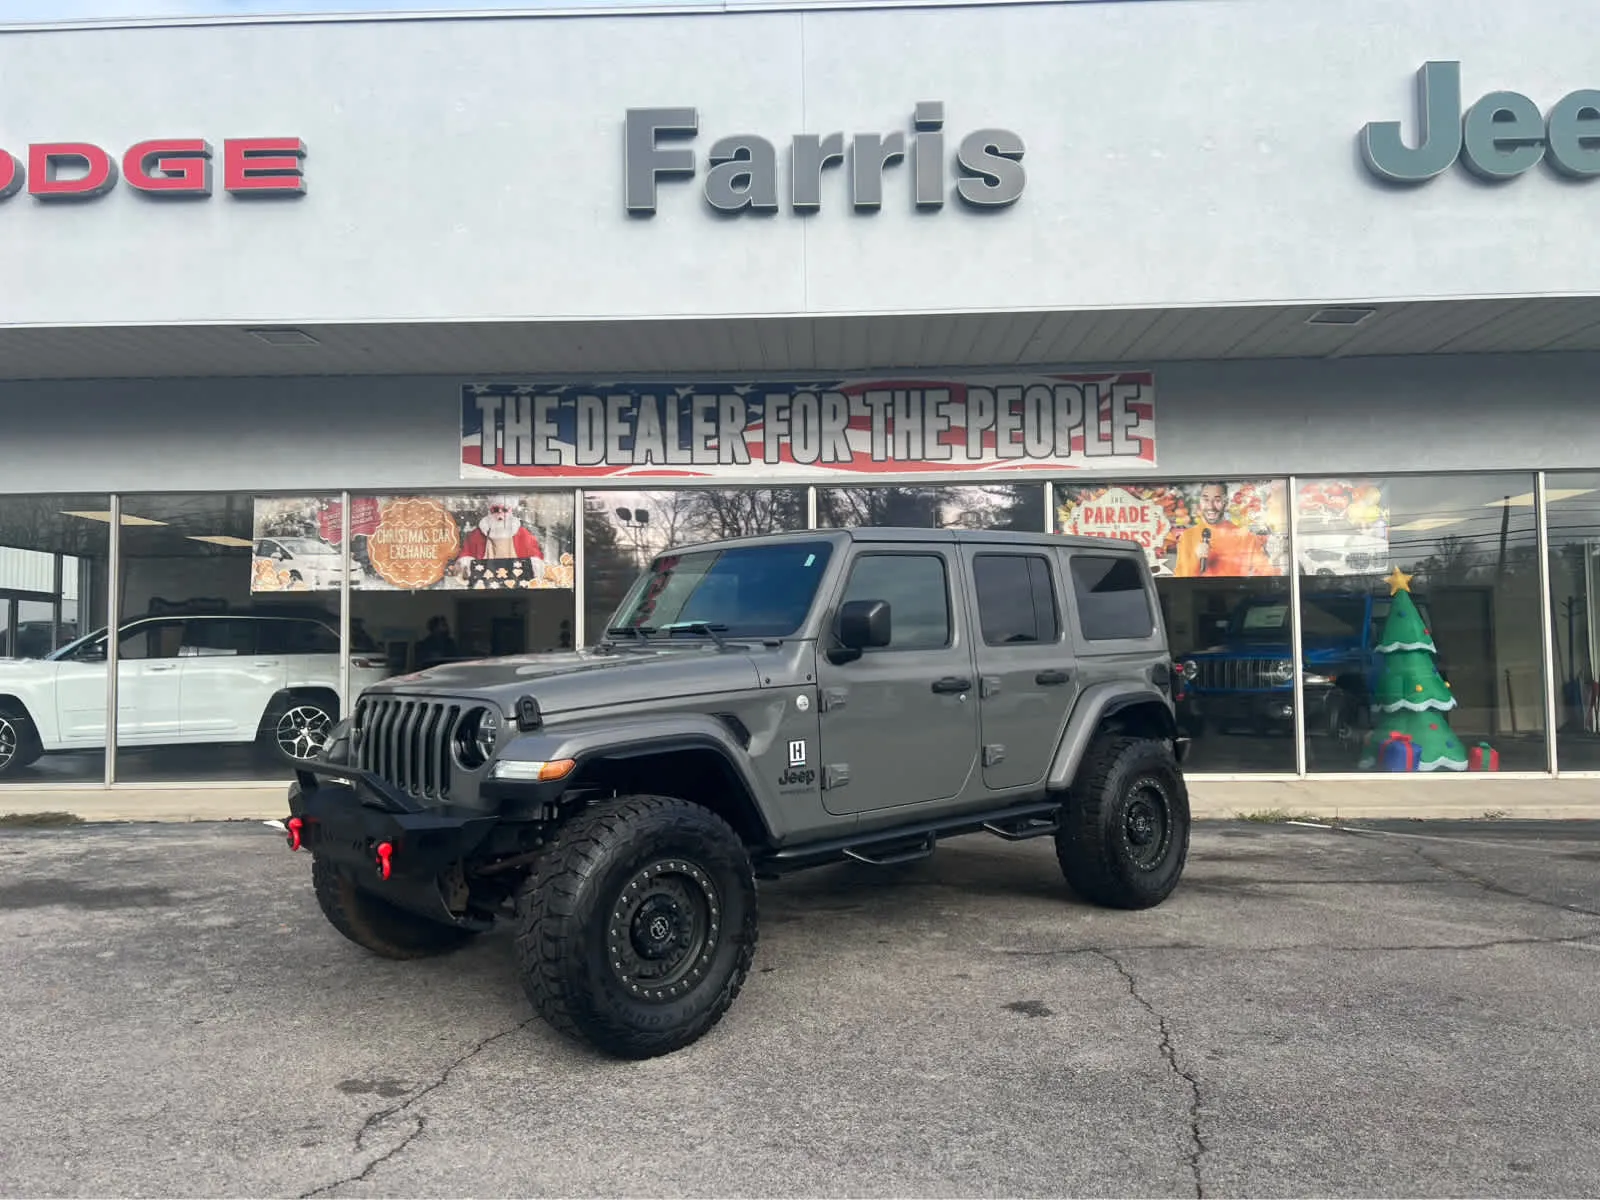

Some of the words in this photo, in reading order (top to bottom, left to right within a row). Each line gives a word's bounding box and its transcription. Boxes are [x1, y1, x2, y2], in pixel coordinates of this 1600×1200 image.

[1360, 60, 1600, 182] Jee
[625, 101, 1027, 214] Farris
[0, 138, 306, 199] DGE
[475, 394, 562, 466] THE
[574, 393, 752, 466] DEALER
[763, 390, 853, 464] FOR
[863, 387, 952, 462] THE
[965, 383, 1140, 460] PEOPLE
[1084, 505, 1151, 524] PARADE
[376, 529, 430, 544] CHRISTMAS
[432, 528, 450, 542] CAR
[1083, 530, 1151, 547] DES
[390, 544, 439, 560] EXCHANGE
[778, 769, 815, 785] Jeep
